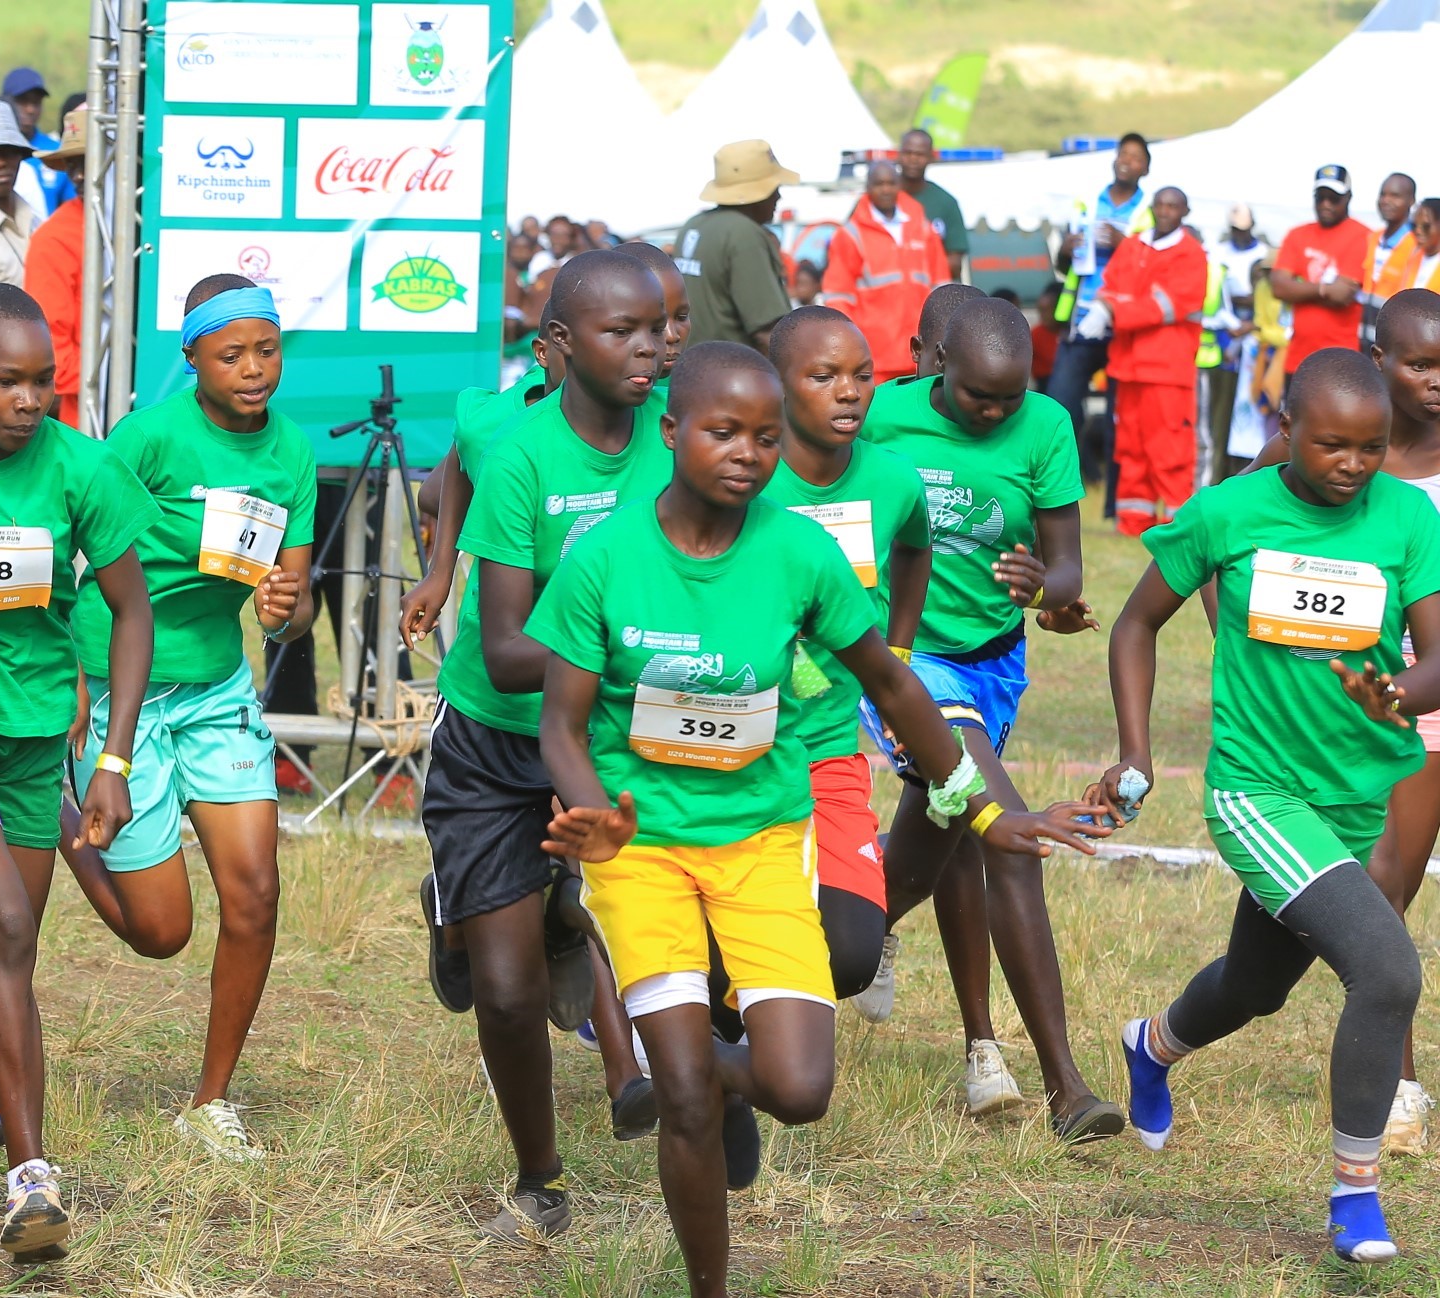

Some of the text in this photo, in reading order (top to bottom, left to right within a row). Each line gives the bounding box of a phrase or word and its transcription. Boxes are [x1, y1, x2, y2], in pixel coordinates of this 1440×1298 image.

[182, 53, 215, 65] KICD
[177, 174, 271, 190] Kipchimchim
[202, 190, 245, 203] Group
[383, 277, 457, 298] KABRAS
[566, 498, 601, 507] MOUNTAIN
[1309, 566, 1342, 574] MOUNTAIN
[3, 595, 20, 603] 8km
[1293, 590, 1345, 615] 382
[1282, 629, 1296, 638] U20
[1298, 631, 1325, 641] Women
[642, 637, 700, 647] MOUNTAIN RUN
[679, 718, 736, 740] 392
[667, 750, 684, 758] U20
[685, 751, 716, 762] Women
